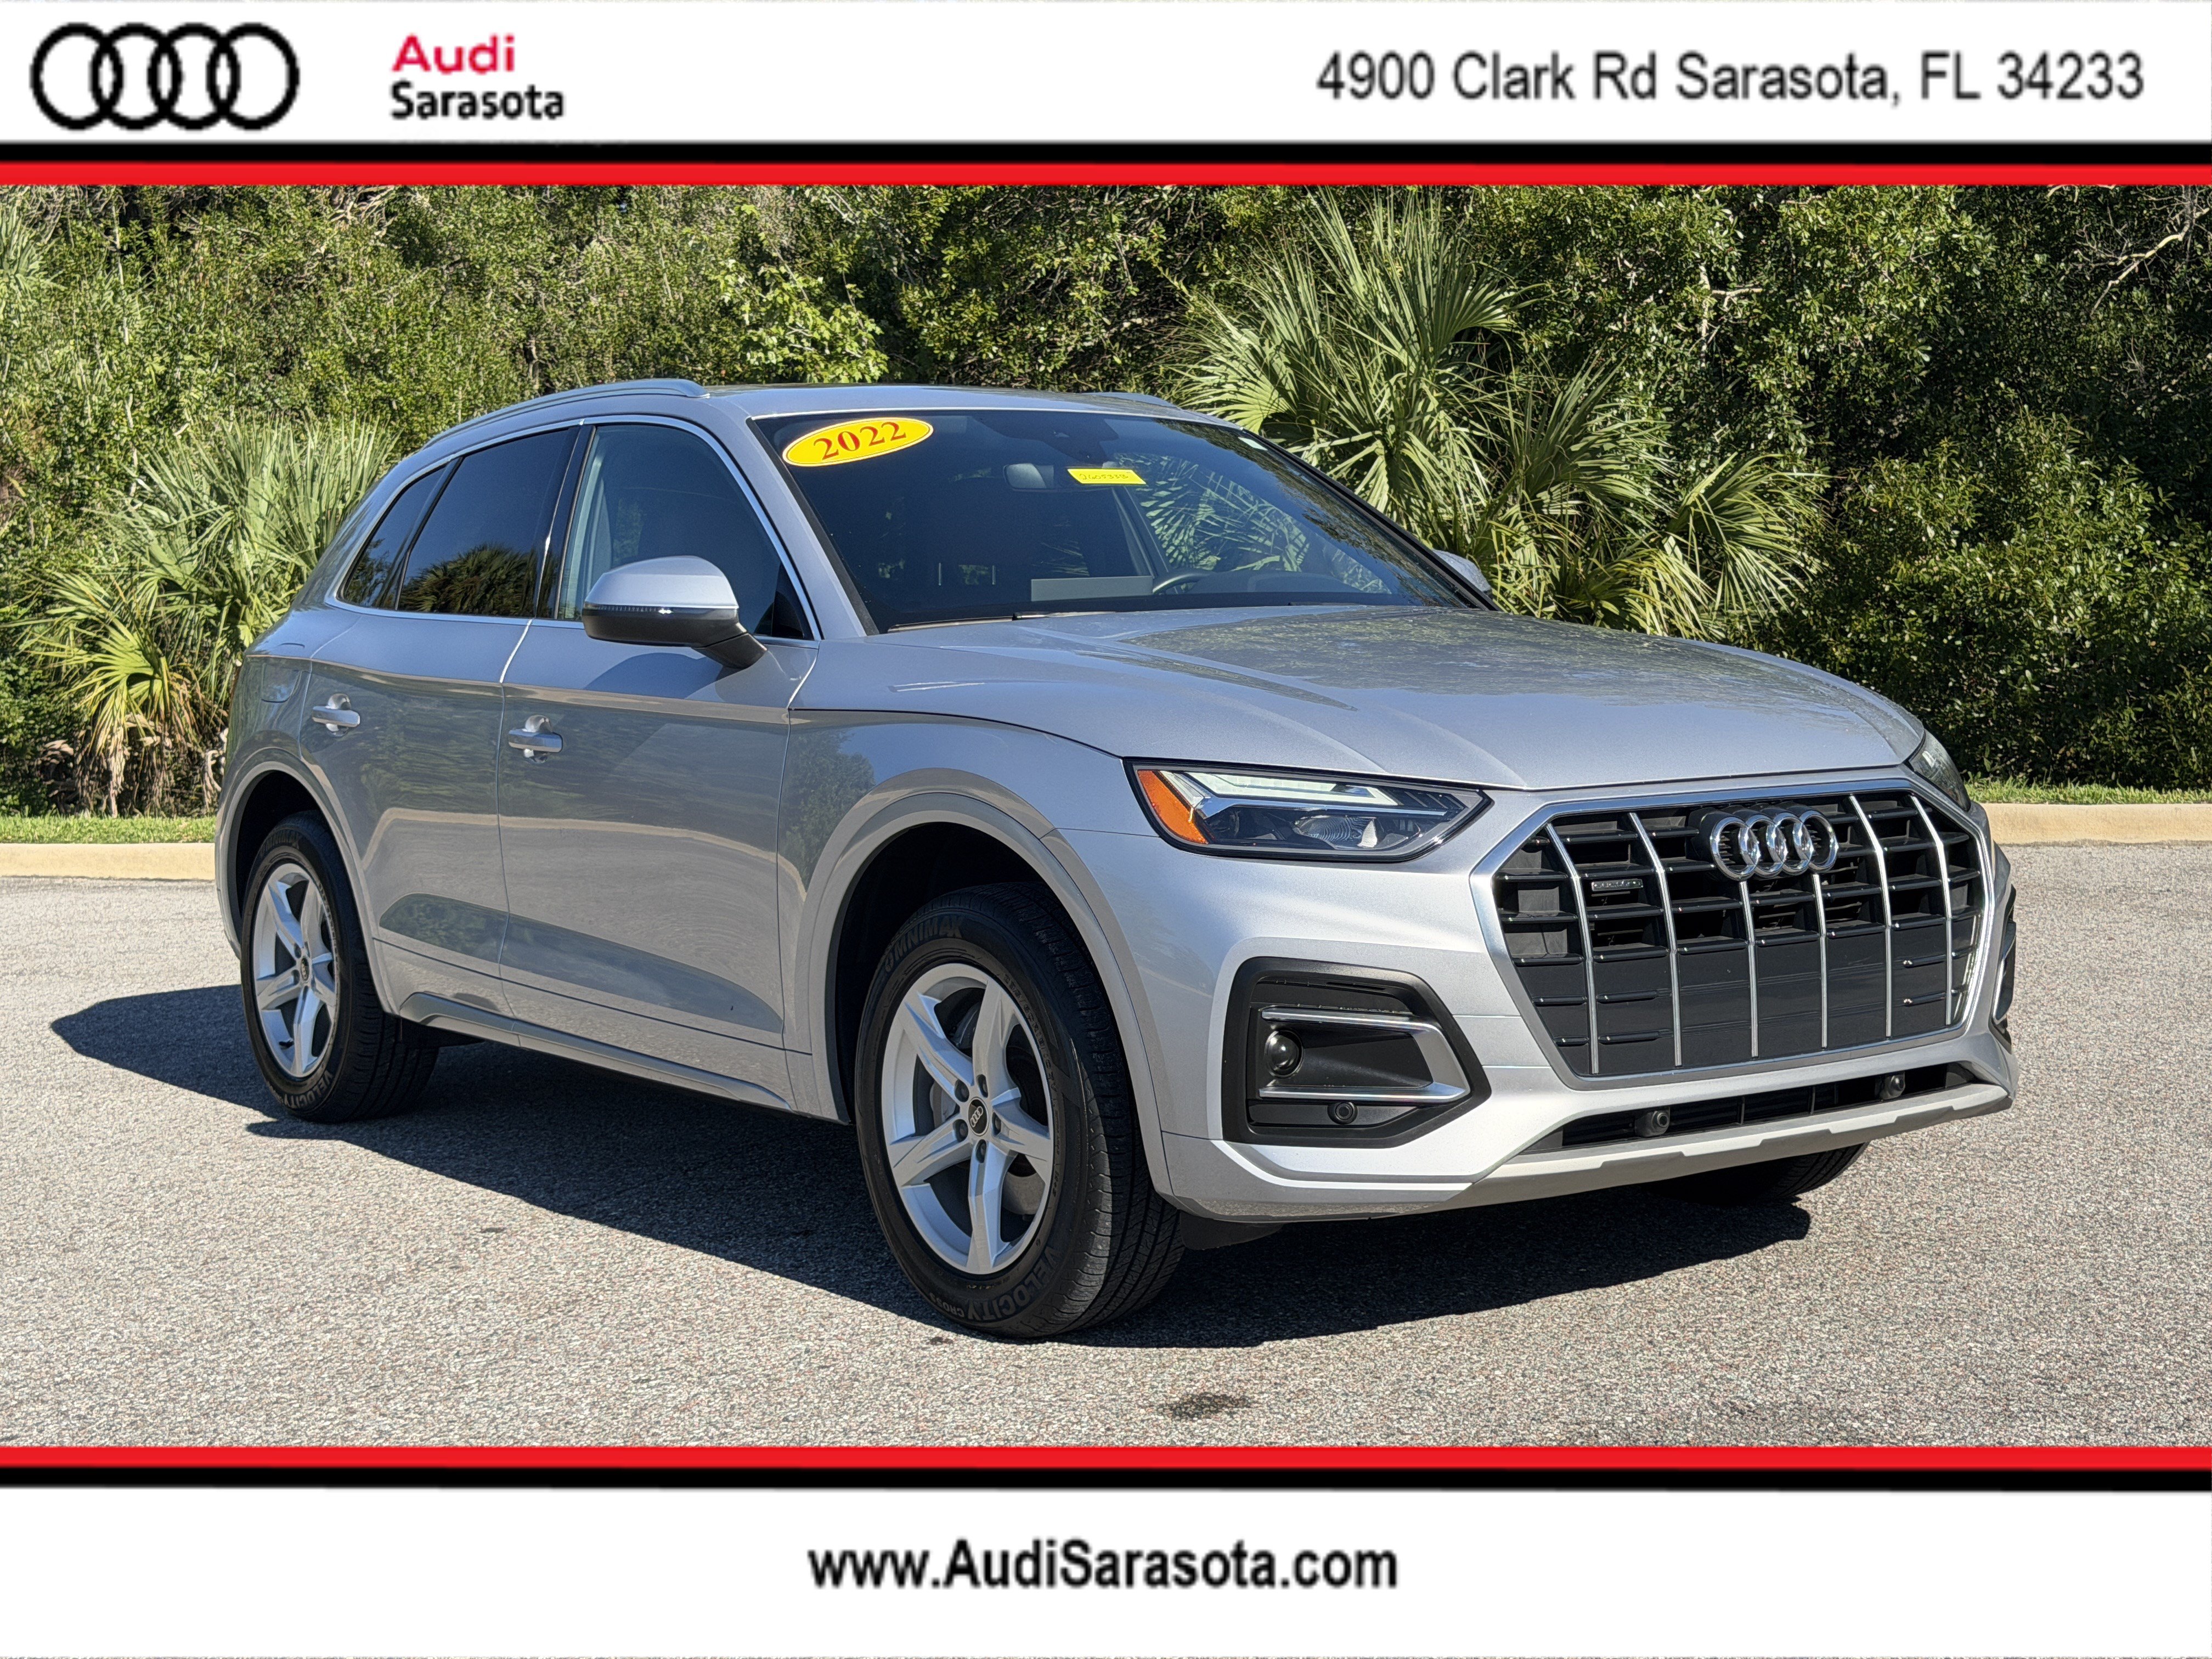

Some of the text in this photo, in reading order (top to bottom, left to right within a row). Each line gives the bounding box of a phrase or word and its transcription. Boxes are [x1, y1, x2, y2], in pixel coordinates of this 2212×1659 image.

[814, 421, 906, 460] 2022
[884, 915, 963, 973] OMNIMAX
[929, 1245, 1062, 1321] VELOCITY CROSS
